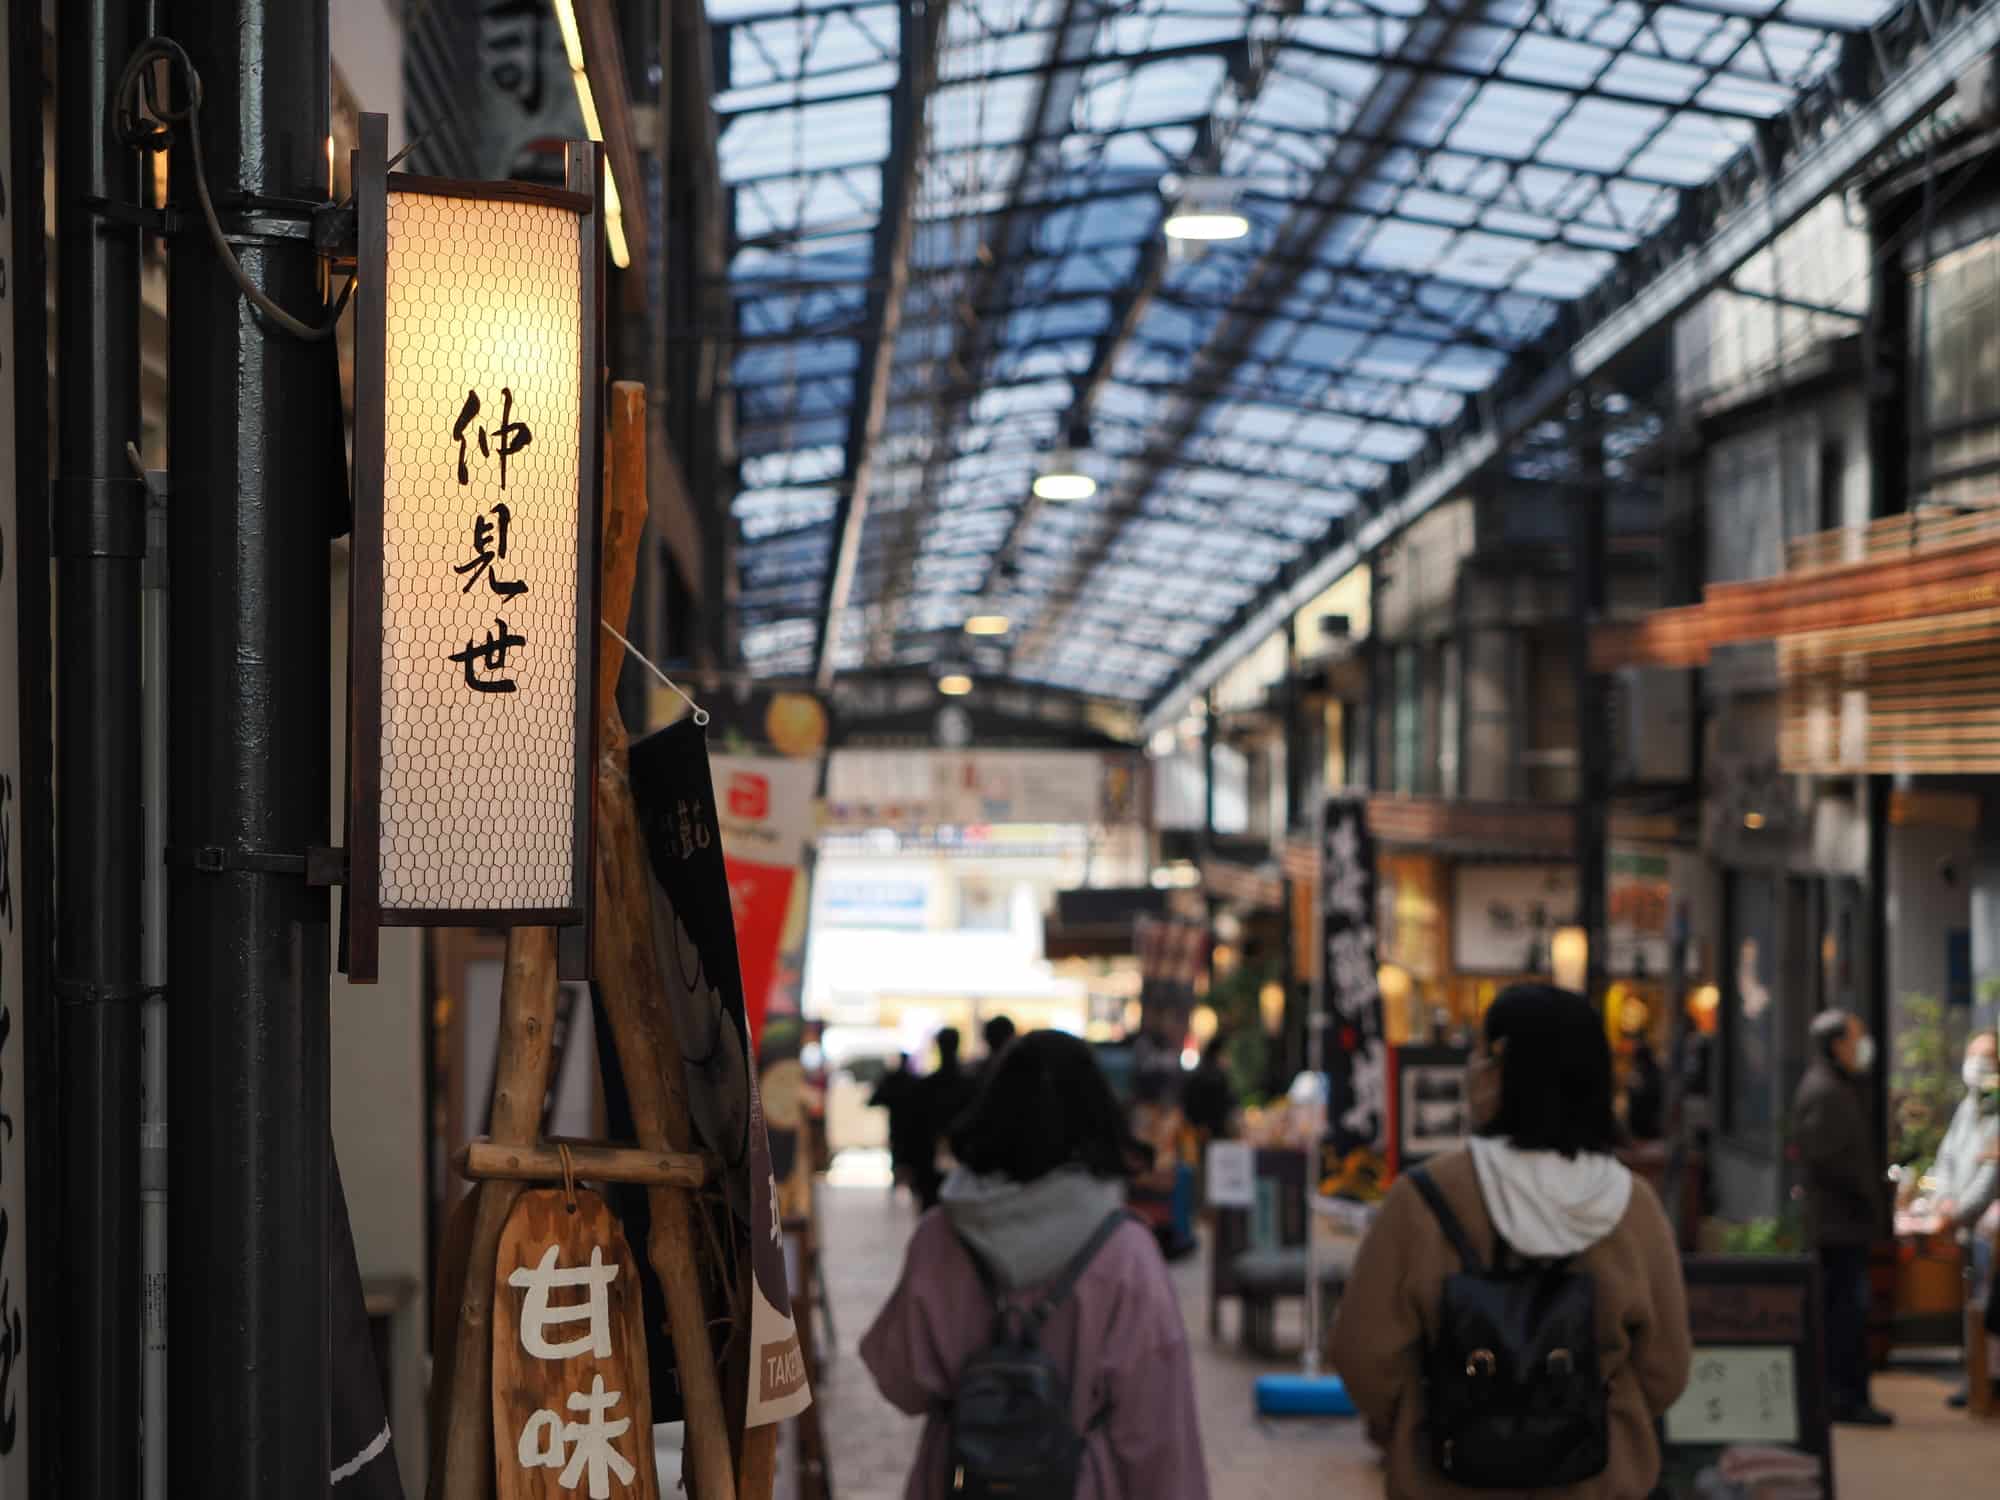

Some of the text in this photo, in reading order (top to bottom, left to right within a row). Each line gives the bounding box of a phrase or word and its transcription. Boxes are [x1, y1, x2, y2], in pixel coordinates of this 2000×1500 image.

[448, 387, 532, 692] 仲見世
[508, 1244, 636, 1500] 甘味
